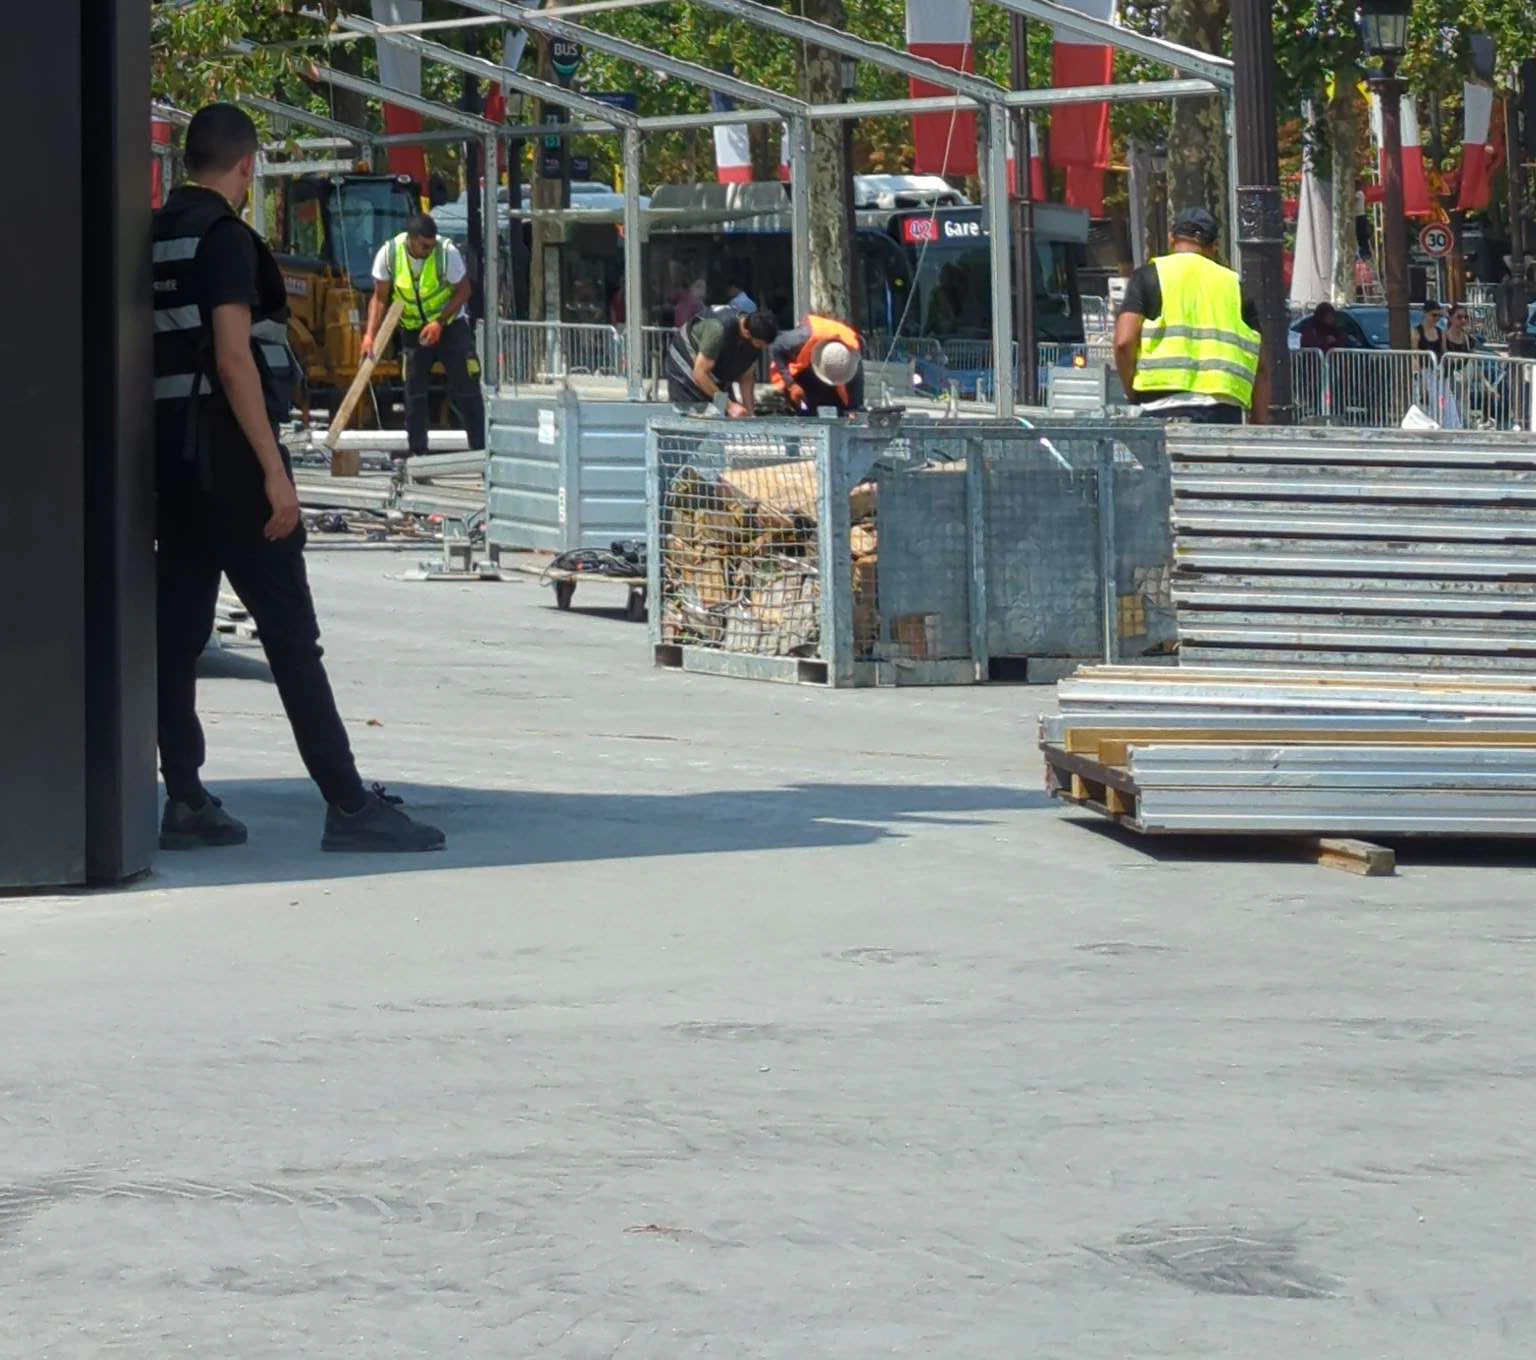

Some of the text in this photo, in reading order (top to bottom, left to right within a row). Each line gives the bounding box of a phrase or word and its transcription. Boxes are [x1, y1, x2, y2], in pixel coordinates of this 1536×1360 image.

[554, 43, 578, 56] BUS
[944, 220, 980, 237] Gare
[1428, 233, 1447, 247] 30
